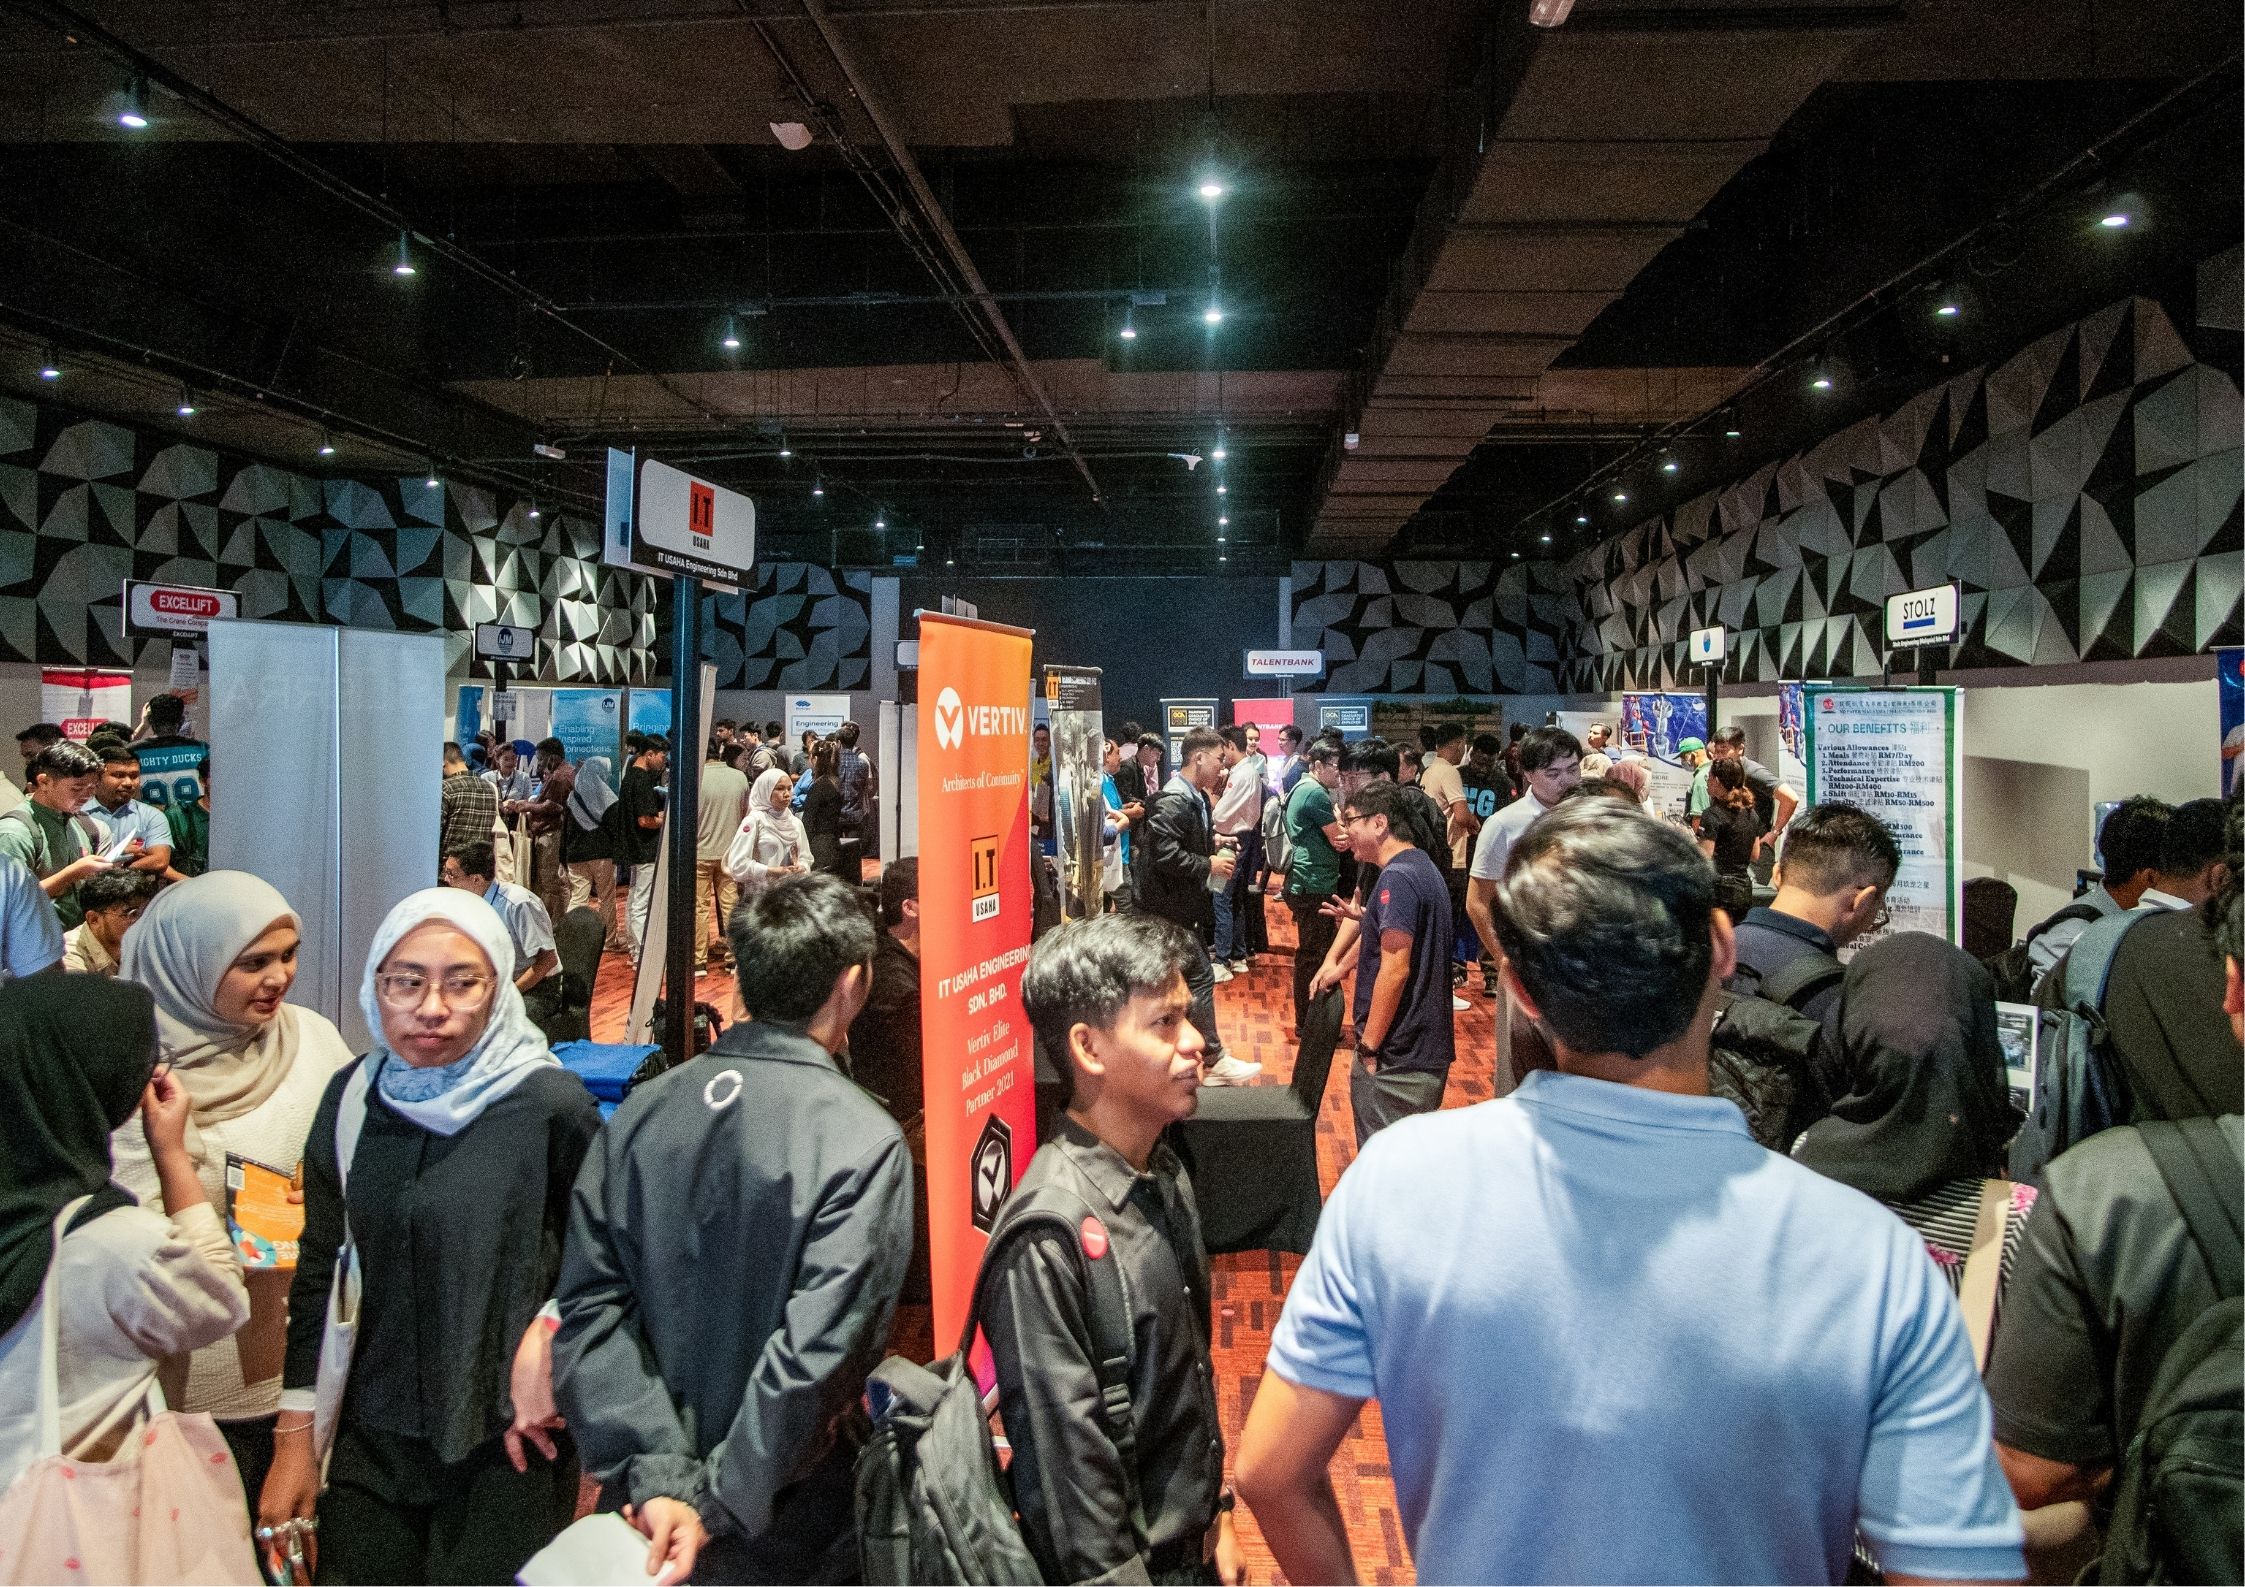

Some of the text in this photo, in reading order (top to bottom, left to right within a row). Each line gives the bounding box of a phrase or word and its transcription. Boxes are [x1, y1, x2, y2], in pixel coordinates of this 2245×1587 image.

[693, 536, 710, 550] USAHA
[658, 552, 738, 581] IT USAHA Engineering Sdn Bhd
[160, 595, 213, 612] EXCELLIFT
[1904, 598, 1935, 620] STOLZ
[559, 724, 594, 734] Enabling
[968, 706, 1026, 736] VERTIV
[1828, 724, 1849, 734] OUR
[1853, 724, 1906, 733] BENEFITS
[140, 753, 202, 767] IGHTY DUCKS
[942, 770, 1022, 792] Architects of Continuity
[976, 899, 996, 916] USAHA
[939, 978, 951, 999] IT
[953, 966, 979, 994] USAHA
[968, 983, 1007, 1015] SDN. BHD.
[968, 1020, 1010, 1055] Vertiv Elite
[962, 1038, 1018, 1090] Black Diamond
[966, 1071, 1014, 1116] Partner 2021
